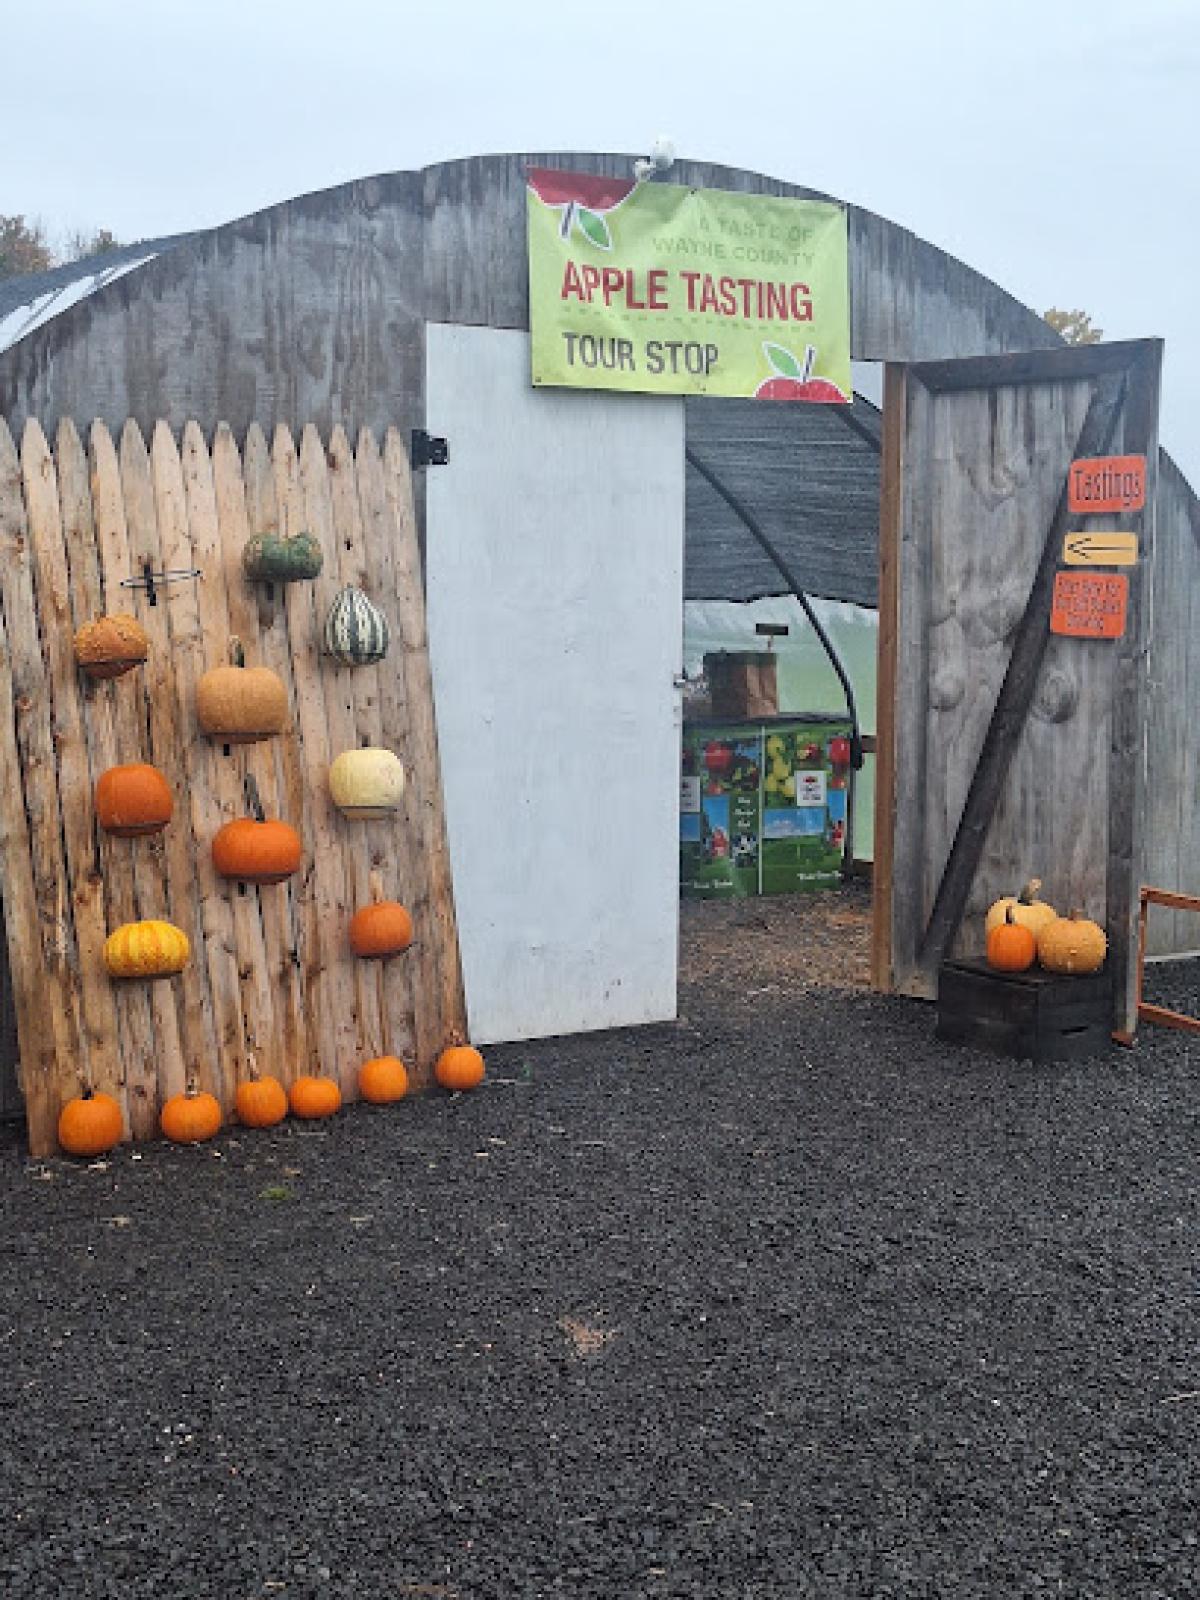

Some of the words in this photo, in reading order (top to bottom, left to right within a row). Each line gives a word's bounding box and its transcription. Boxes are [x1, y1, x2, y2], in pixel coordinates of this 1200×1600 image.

[719, 218, 782, 239] TASTE
[787, 223, 814, 242] OF
[653, 237, 727, 261] WAYNE
[732, 246, 816, 267] COUNTY
[561, 260, 668, 310] APPLE
[679, 271, 814, 322] TASTING
[562, 332, 636, 371] TOUR
[646, 340, 719, 375] STOP
[1074, 464, 1140, 506] Tastings
